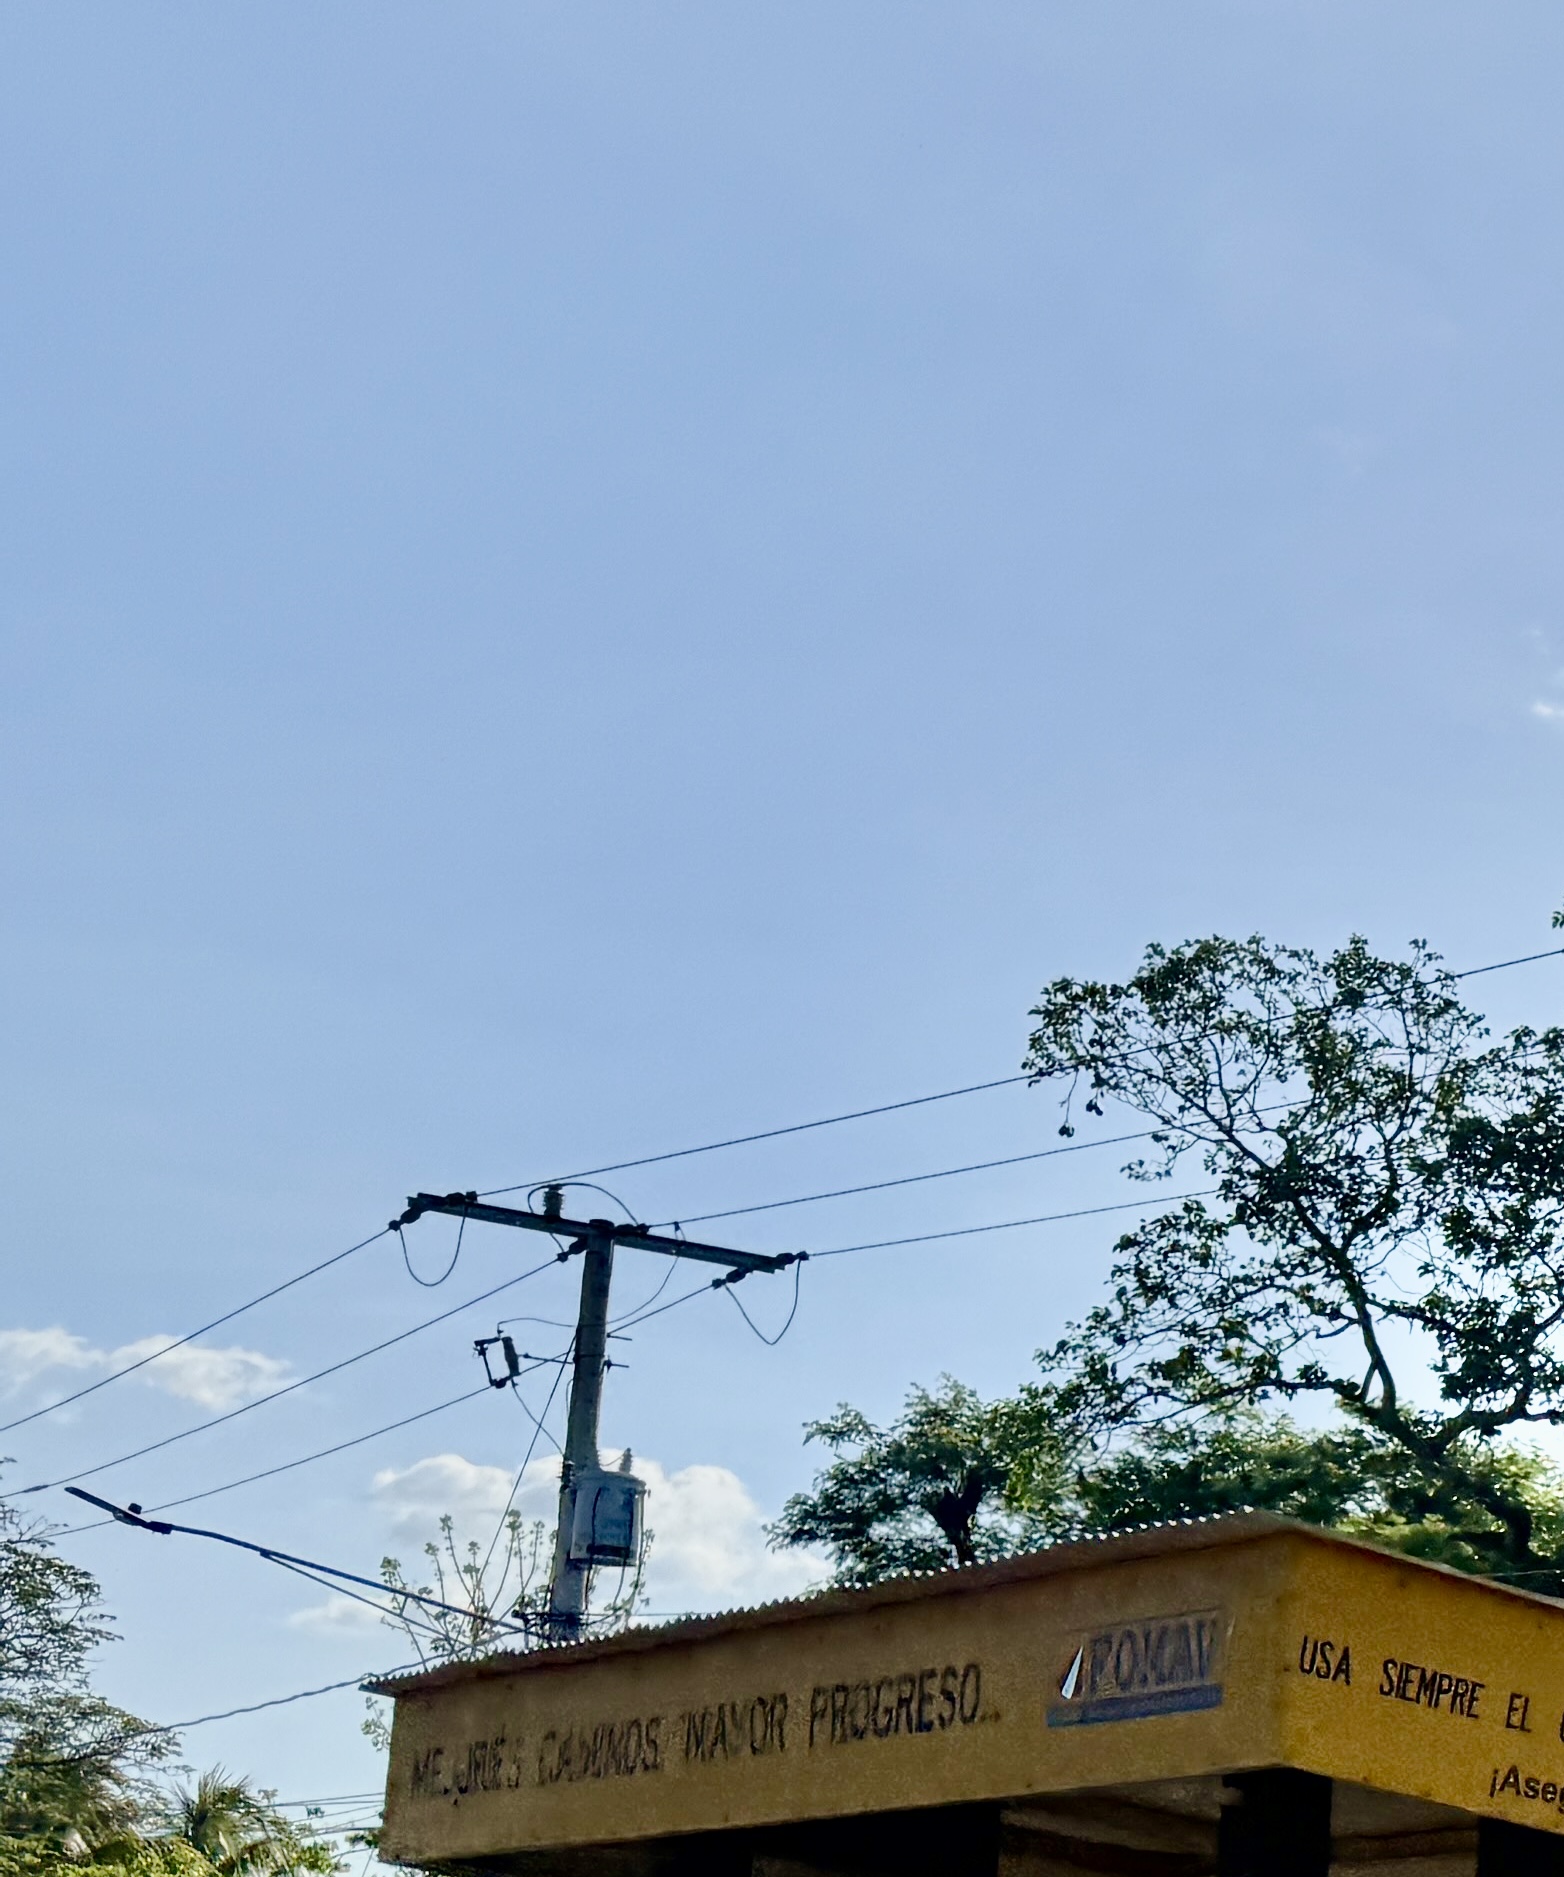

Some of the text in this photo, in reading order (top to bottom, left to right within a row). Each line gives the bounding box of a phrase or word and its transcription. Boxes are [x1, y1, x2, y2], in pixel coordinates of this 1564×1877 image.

[1299, 1634, 1351, 1686] USA
[1379, 1657, 1485, 1719] SIEMPRE
[1505, 1692, 1532, 1734] EL
